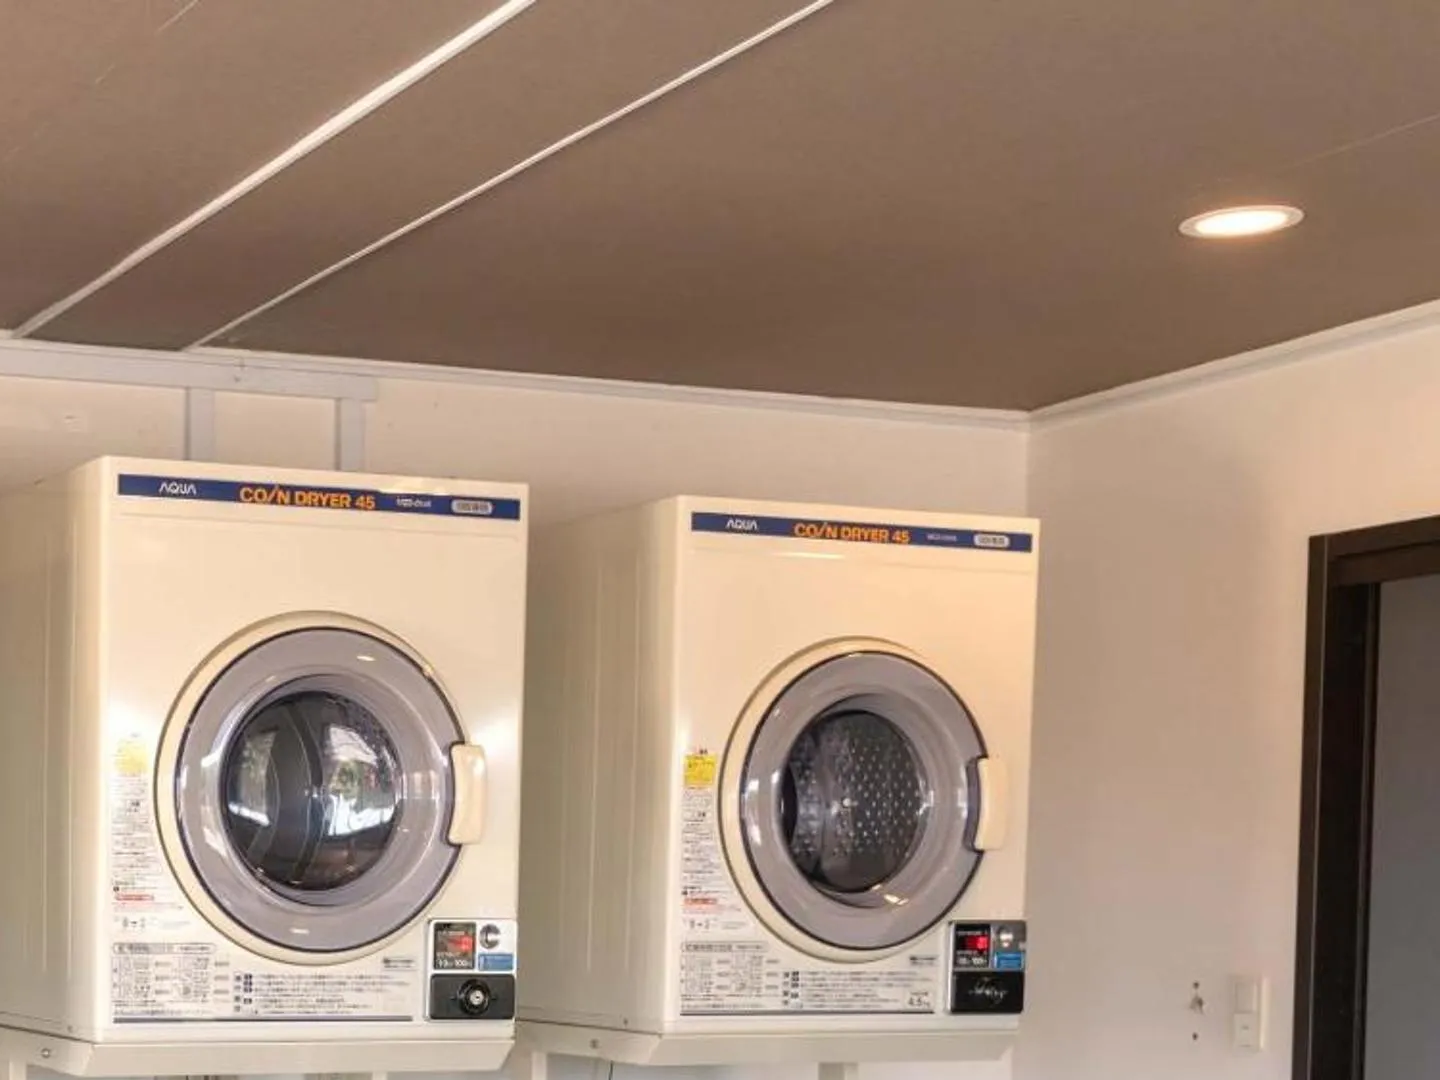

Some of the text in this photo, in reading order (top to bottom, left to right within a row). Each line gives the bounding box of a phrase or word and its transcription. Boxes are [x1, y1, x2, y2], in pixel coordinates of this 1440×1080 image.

[158, 481, 197, 495] AQUA
[294, 490, 351, 508] DRYER
[355, 495, 375, 509] 45
[725, 518, 758, 531] AQUA
[841, 526, 888, 542] DRYER
[891, 530, 911, 543] 45
